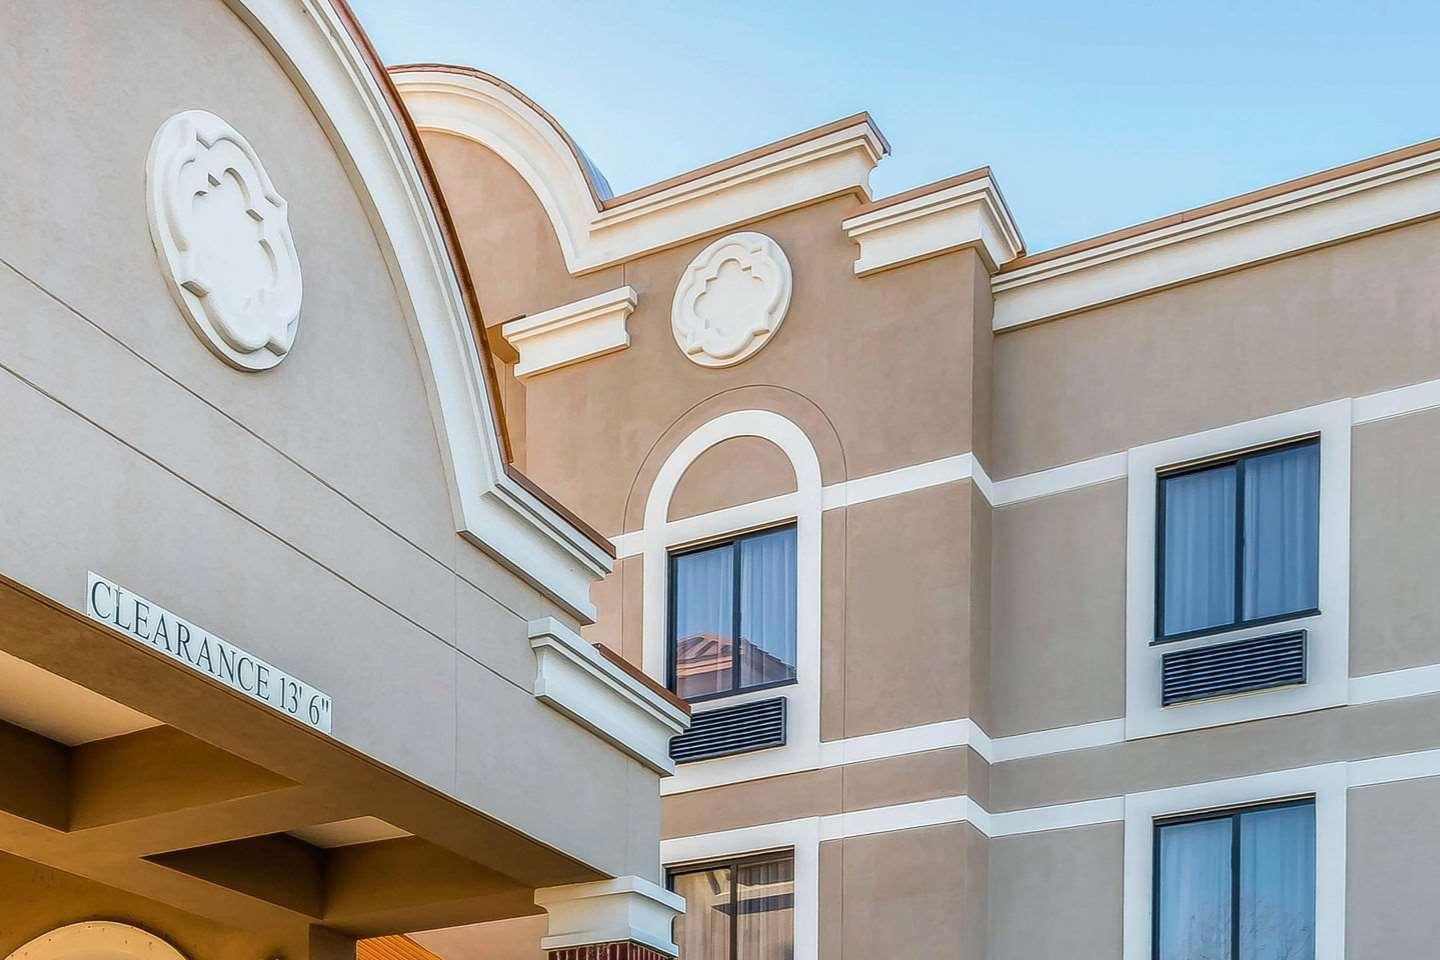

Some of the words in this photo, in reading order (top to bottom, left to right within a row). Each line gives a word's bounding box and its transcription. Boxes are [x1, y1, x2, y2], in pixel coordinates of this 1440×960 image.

[91, 581, 270, 701] CLEARANCE
[280, 677, 302, 713] 13'
[309, 695, 329, 725] 6"
